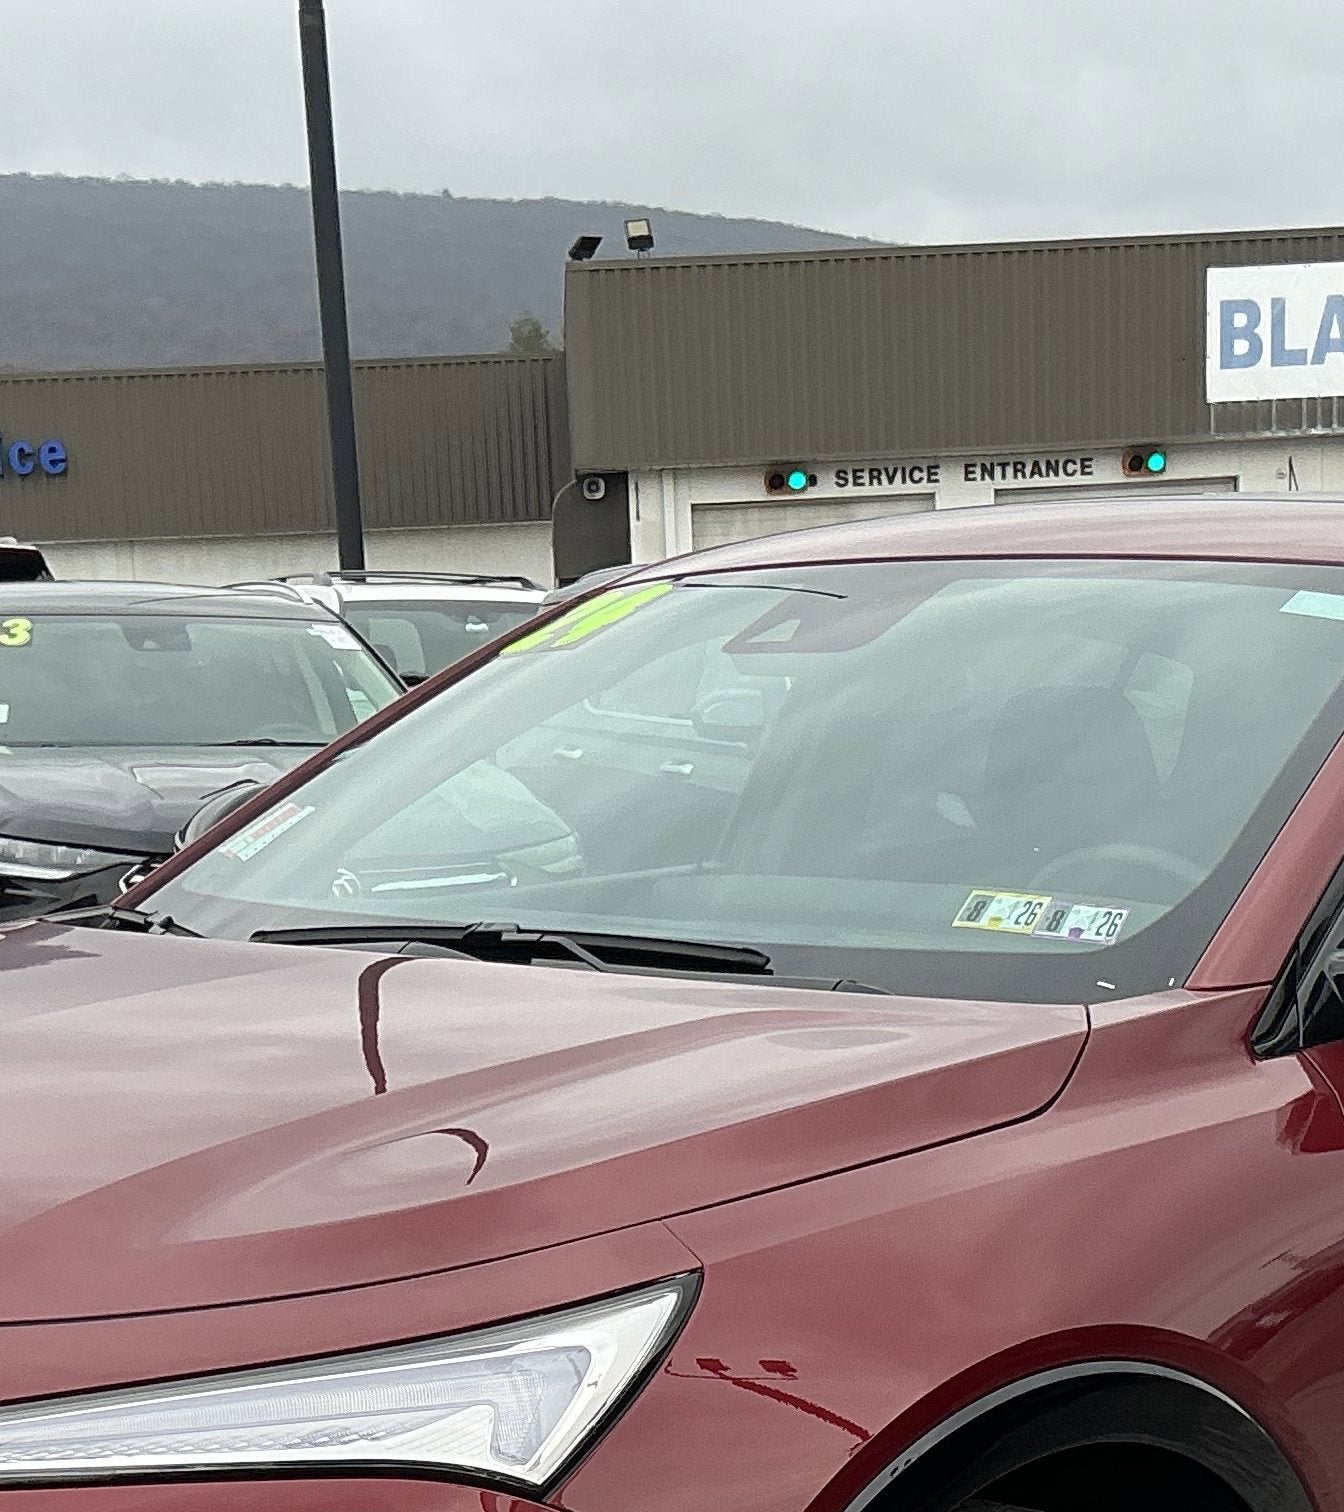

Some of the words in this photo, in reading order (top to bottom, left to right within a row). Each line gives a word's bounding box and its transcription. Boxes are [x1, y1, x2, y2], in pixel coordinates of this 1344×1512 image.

[834, 464, 941, 488] SERVICE
[964, 457, 1094, 482] ENTRANCE
[1014, 900, 1044, 926] 26
[1046, 909, 1066, 932] 8
[1095, 910, 1123, 938] 26
